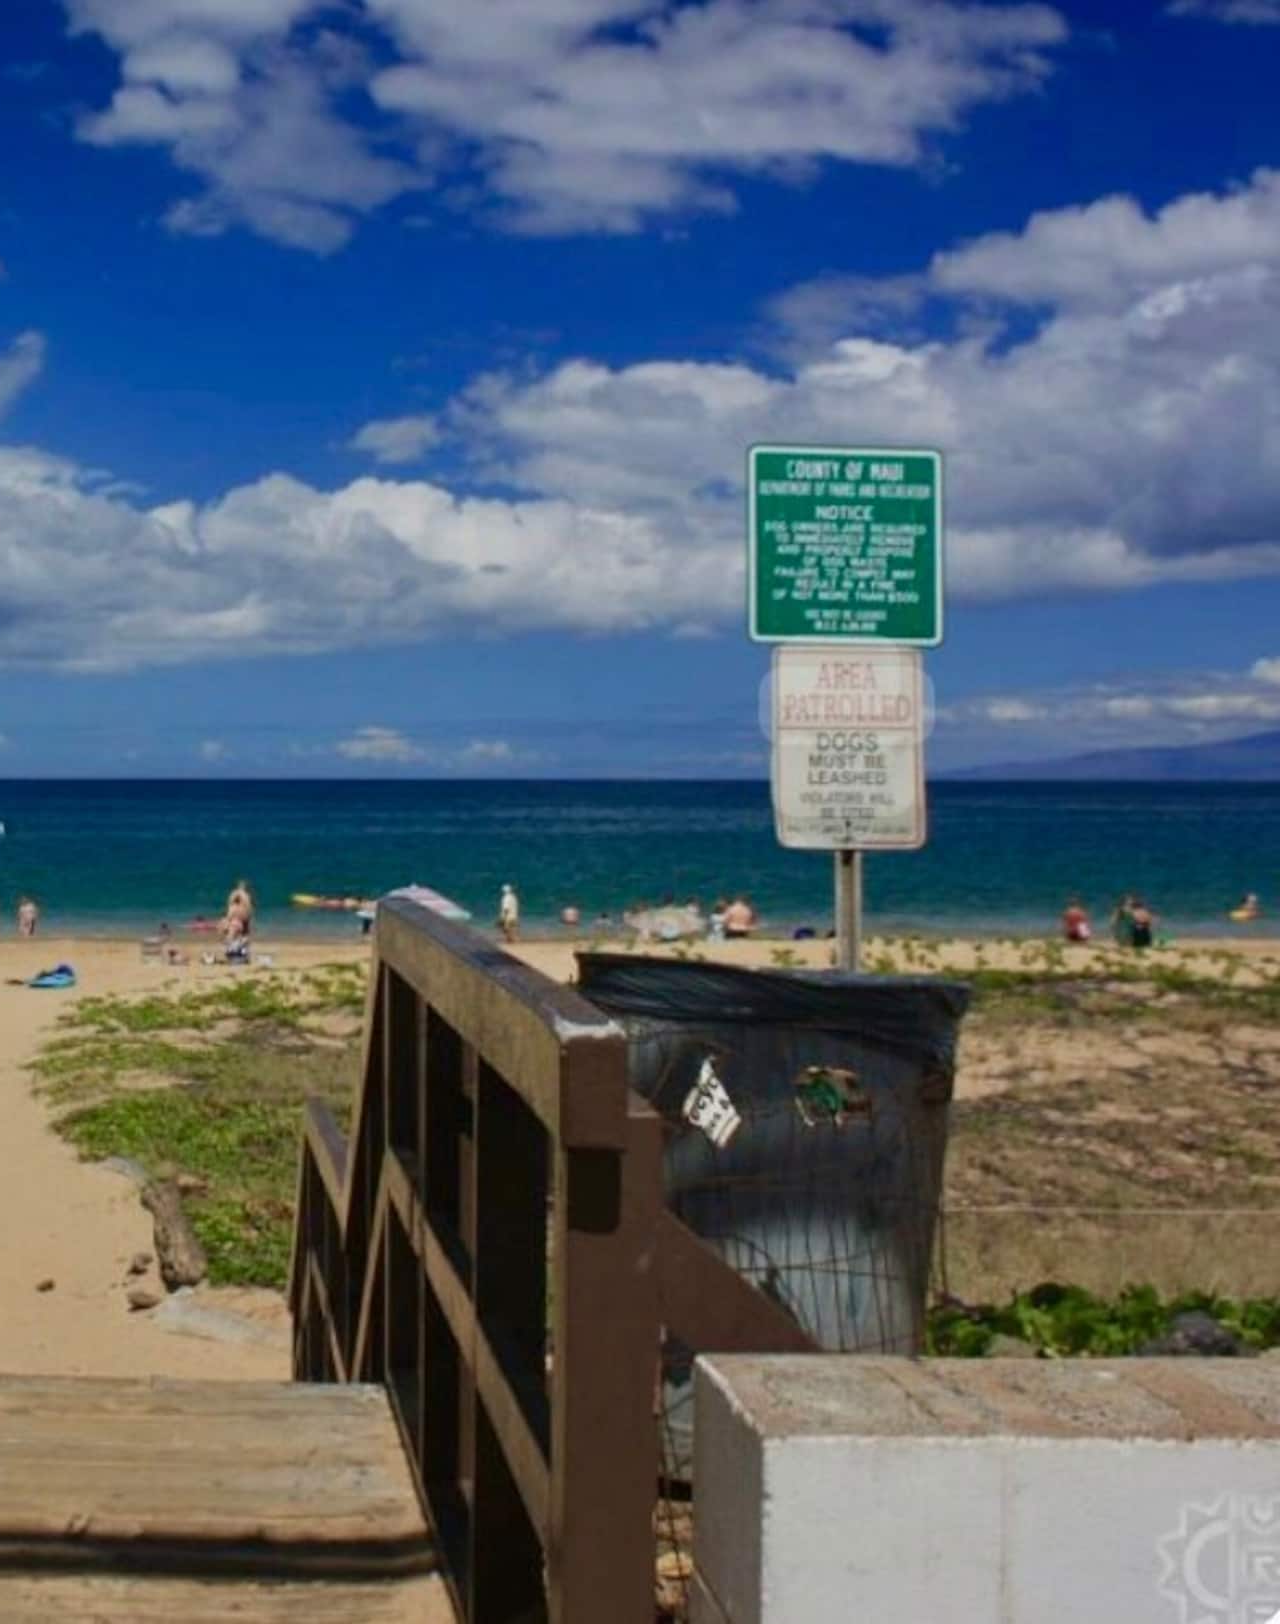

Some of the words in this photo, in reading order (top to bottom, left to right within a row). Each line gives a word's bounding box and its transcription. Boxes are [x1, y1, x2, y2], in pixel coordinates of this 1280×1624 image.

[786, 460, 840, 480] COUNTY
[845, 461, 864, 480] OF
[870, 462, 904, 481] MAUI
[815, 505, 874, 520] NOTICE
[817, 661, 877, 689] AREA
[783, 694, 912, 722] PATROLLED
[816, 732, 879, 751] DOGS
[808, 754, 857, 769] MUST
[863, 754, 886, 769] BE
[807, 770, 887, 785] LEASHED
